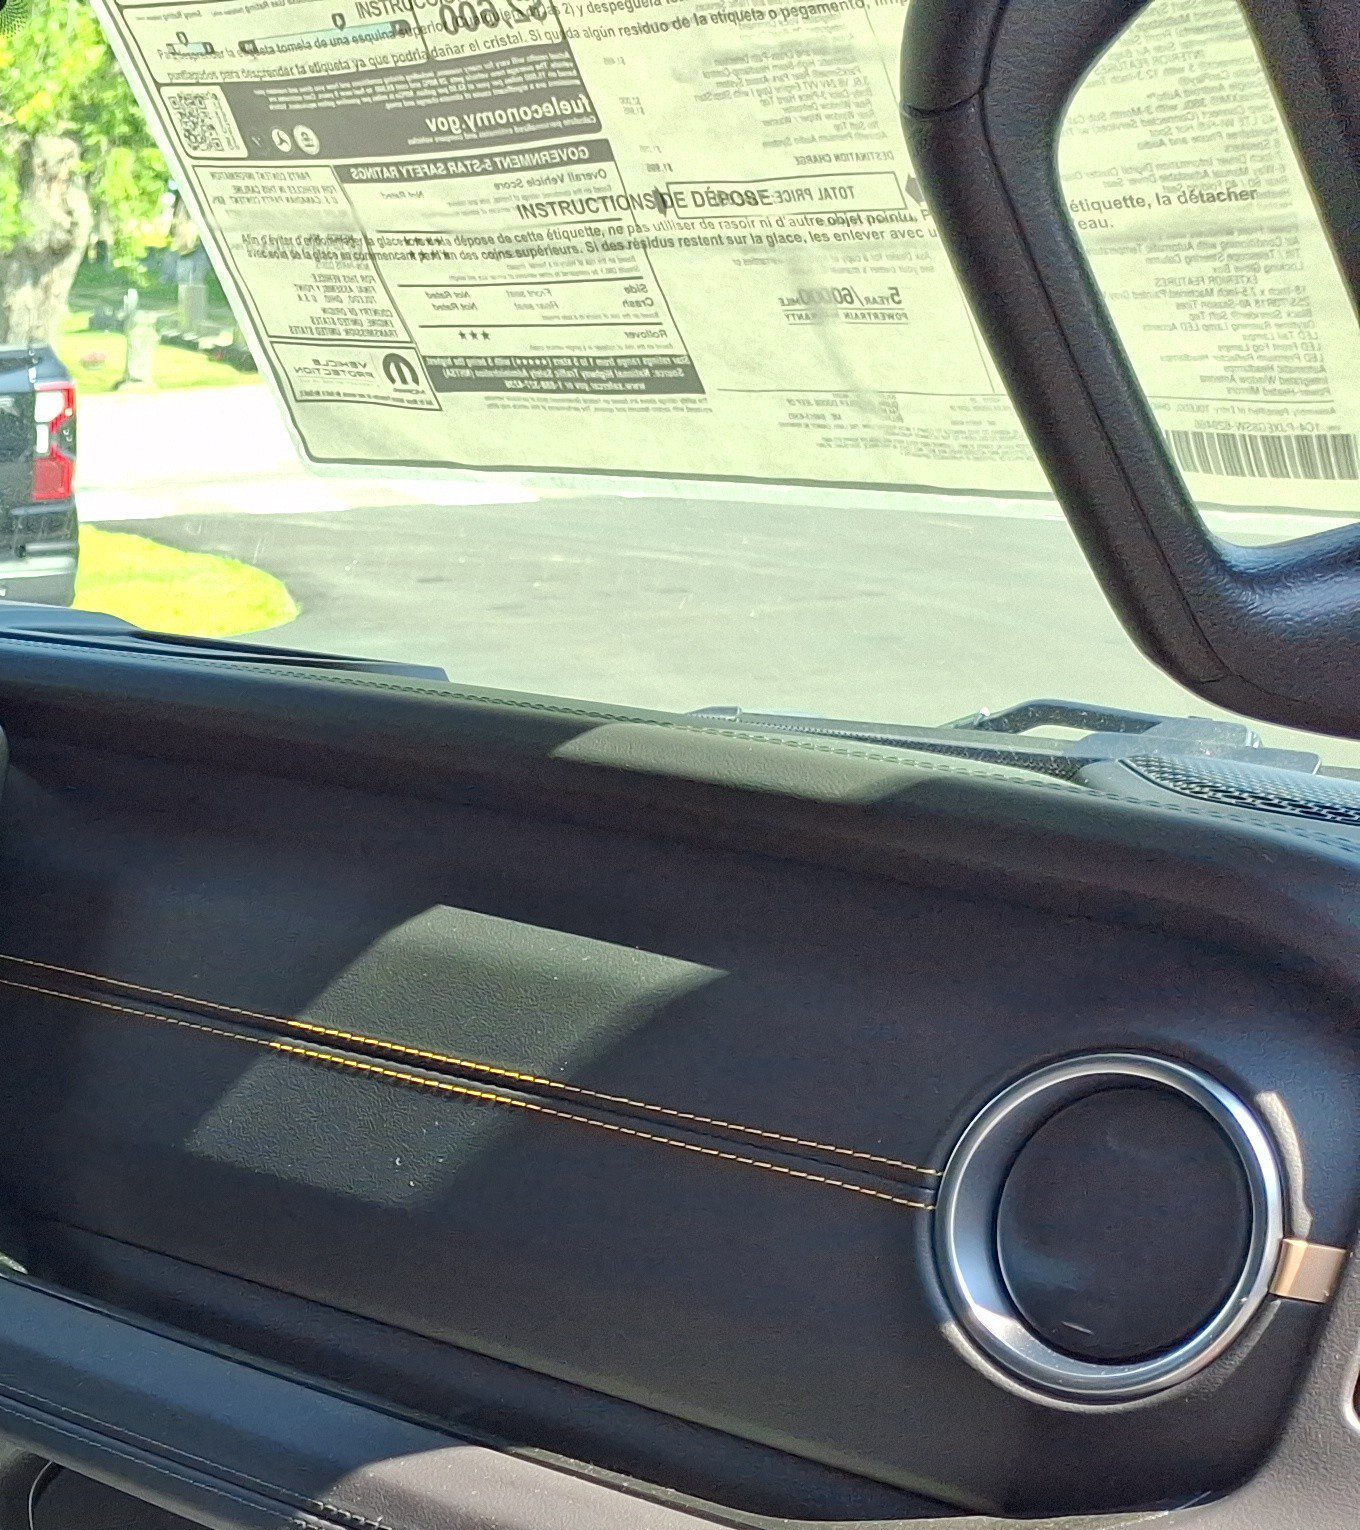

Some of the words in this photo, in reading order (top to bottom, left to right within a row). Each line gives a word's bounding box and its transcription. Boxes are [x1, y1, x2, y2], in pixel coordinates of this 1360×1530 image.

[330, 35, 349, 46] una
[352, 58, 366, 72] ya
[369, 55, 389, 71] que
[431, 42, 465, 60] dañar
[469, 39, 480, 52] el
[483, 31, 527, 50] cristal.
[529, 28, 541, 43] Si
[583, 24, 615, 42] algún
[618, 19, 668, 37] residuo
[672, 14, 691, 30] de
[693, 12, 708, 27] la
[710, 8, 765, 26] etiqueta
[768, 10, 778, 21] o
[516, 192, 657, 220] INSTRUCTIONS
[660, 191, 687, 209] DE
[691, 185, 773, 208] DÉPOSE
[1070, 194, 1152, 213] étiquette,
[1156, 192, 1172, 206] la
[1177, 187, 1258, 205] détacher
[454, 233, 494, 250] dépose
[497, 233, 512, 244] de
[513, 231, 544, 243] cette
[546, 225, 605, 243] étiquette,
[608, 224, 623, 236] ne
[627, 222, 650, 240] pas
[653, 218, 695, 233] utiliser
[698, 217, 715, 231] de
[718, 217, 755, 231] rasoir
[760, 216, 772, 228] ni
[776, 214, 823, 228] d'autre
[826, 212, 863, 230] objet
[481, 247, 512, 262] coins
[515, 241, 584, 260] supérieurs.
[586, 239, 599, 253] Si
[601, 238, 624, 252] des
[629, 236, 675, 250] résidus
[678, 234, 724, 247] restent
[727, 235, 747, 246] sur
[751, 231, 763, 245] la
[766, 231, 807, 247] glace,
[810, 229, 830, 243] les
[833, 228, 885, 242] enlever
[890, 227, 925, 239] avec
